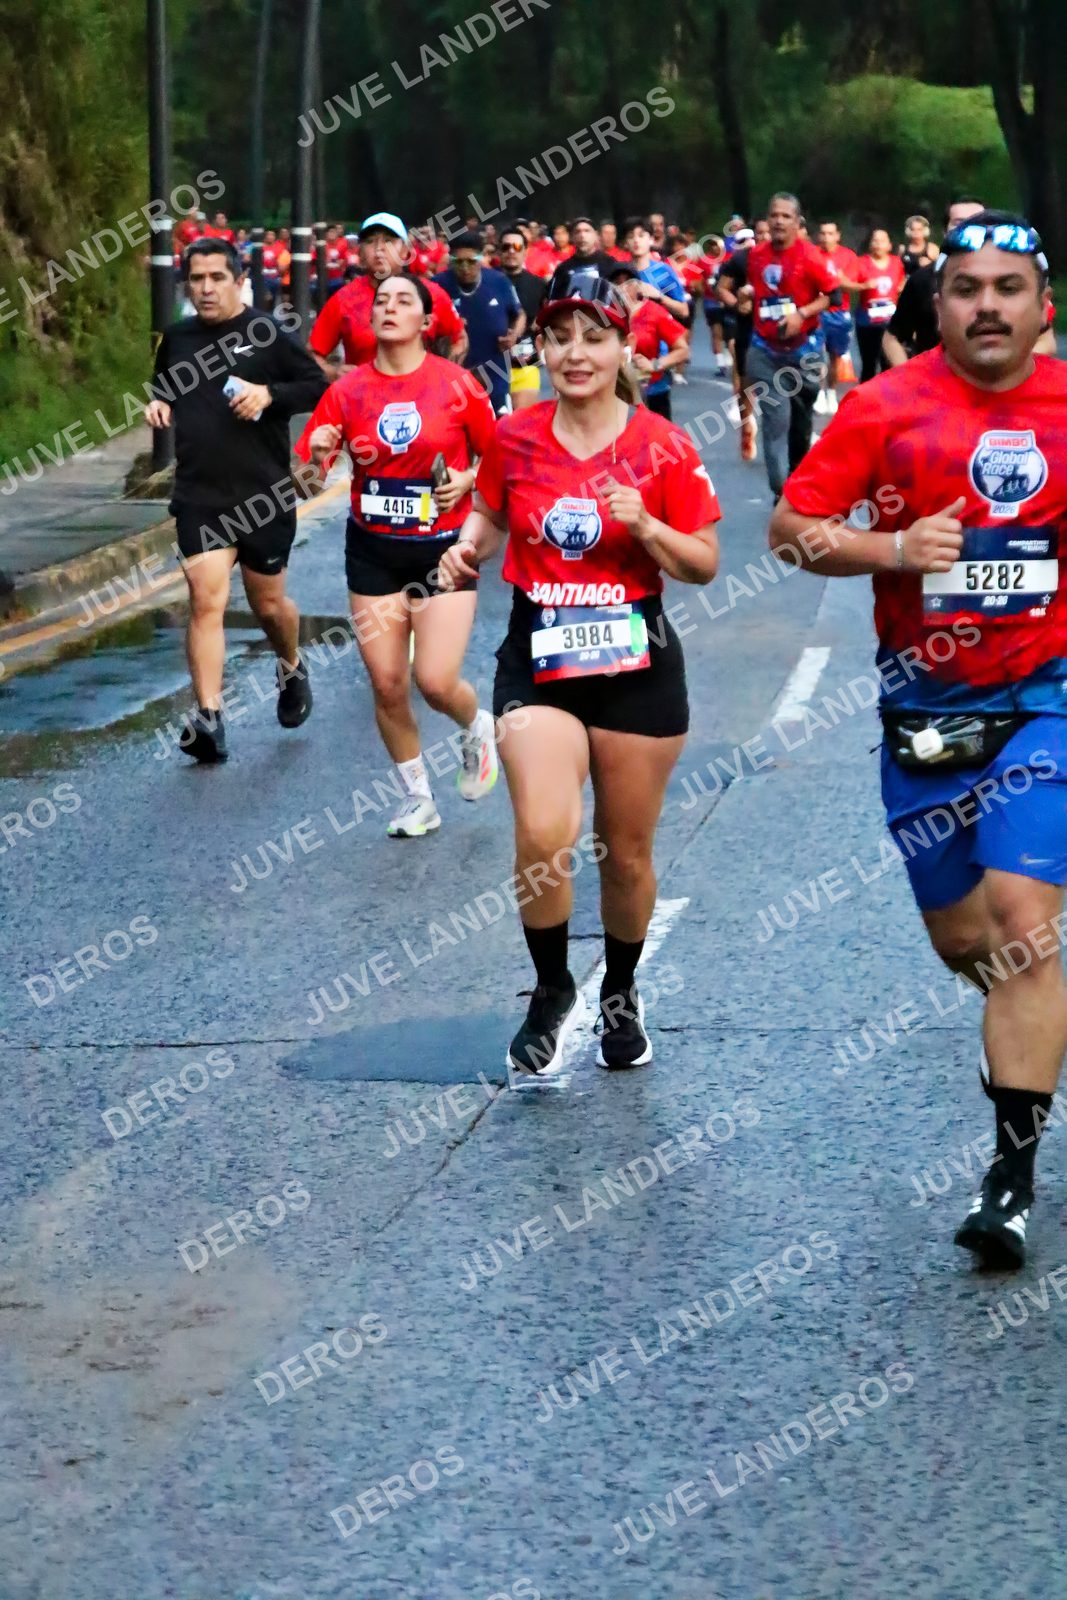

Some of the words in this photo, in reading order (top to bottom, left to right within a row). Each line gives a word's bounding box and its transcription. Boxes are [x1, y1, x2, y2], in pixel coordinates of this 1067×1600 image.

[990, 451, 1029, 465] Global
[982, 464, 1014, 476] Race
[383, 498, 414, 515] 4415
[966, 562, 1025, 591] 5282
[527, 582, 626, 606] SANTIAGO
[562, 623, 614, 650] 3984
